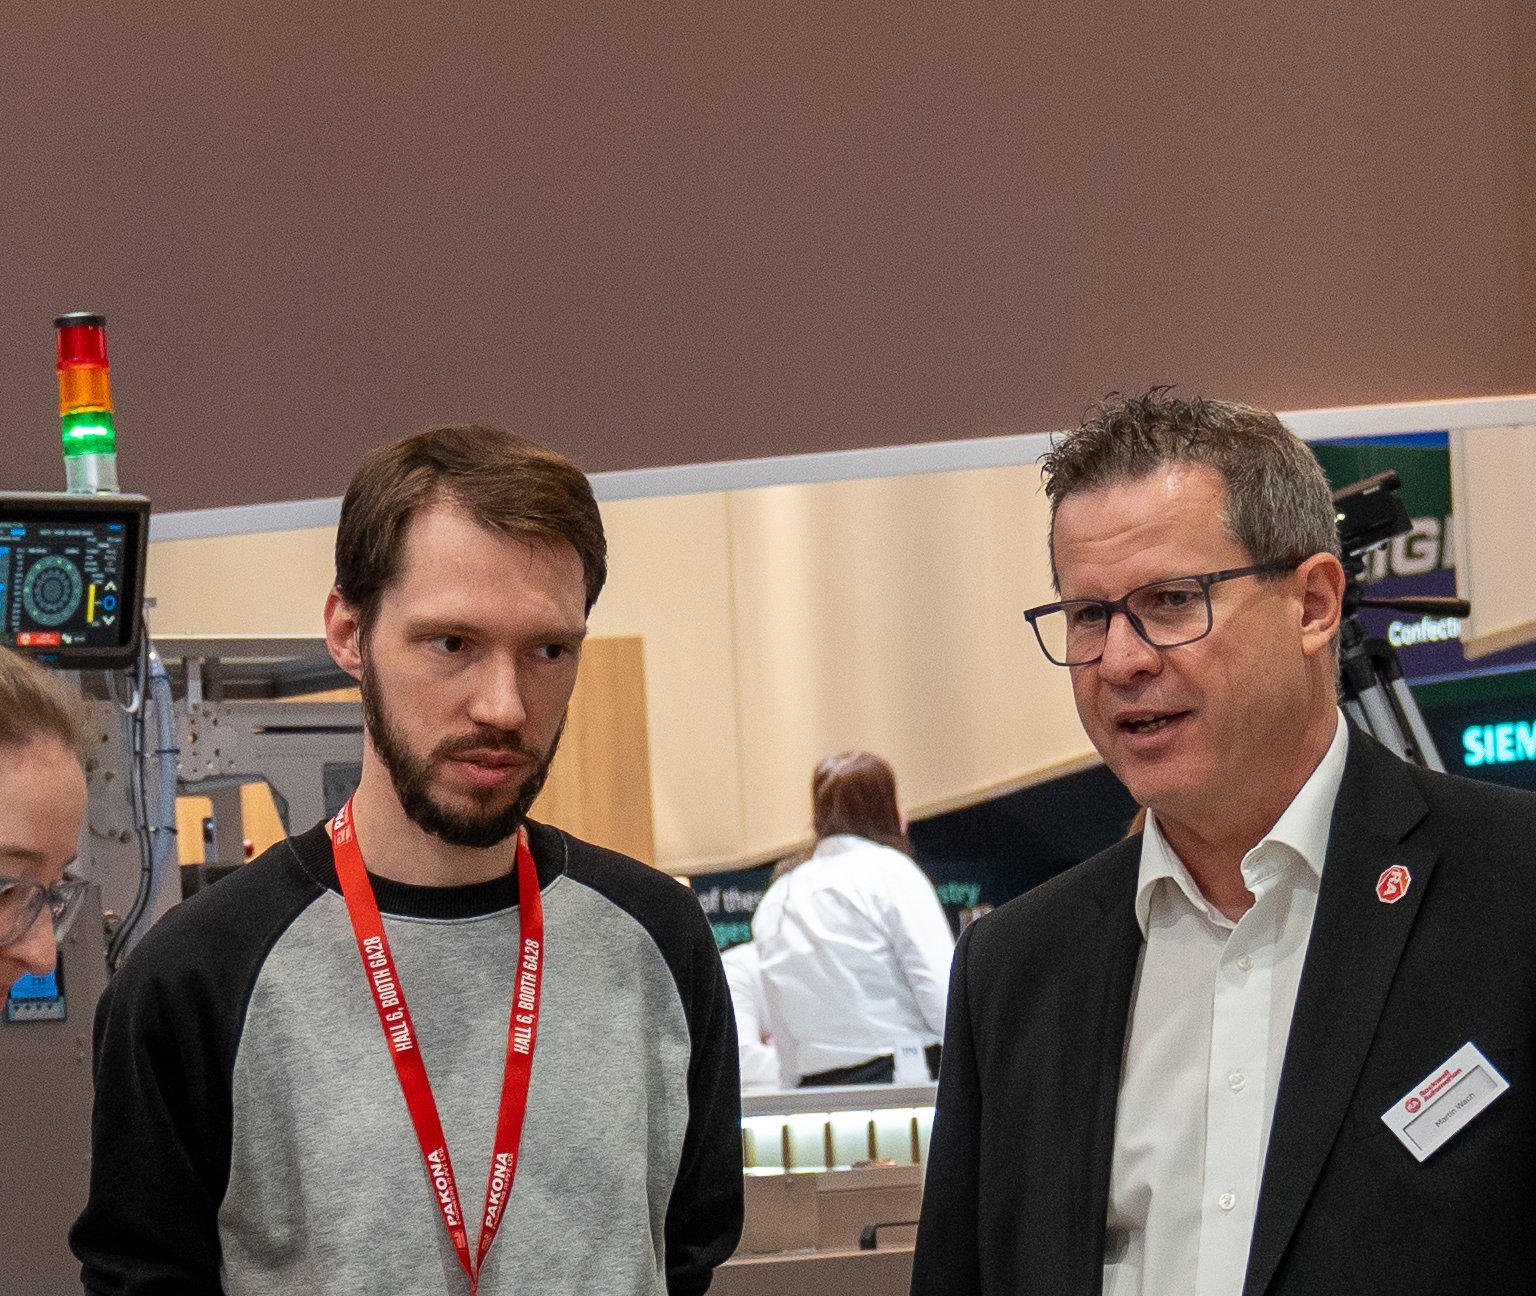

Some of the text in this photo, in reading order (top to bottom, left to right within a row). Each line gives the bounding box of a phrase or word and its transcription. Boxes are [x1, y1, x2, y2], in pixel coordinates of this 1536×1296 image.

[364, 935, 413, 1052] HALL 6, BOOTH 6A28
[514, 938, 539, 1054] HALL 6, BOOTH 6A28
[1419, 1069, 1451, 1098] Rockwell
[1424, 1068, 1462, 1102] Automation
[1434, 1092, 1476, 1128] Martin Wach
[428, 1149, 458, 1226] PAKONA
[485, 1152, 509, 1228] PAKONA
